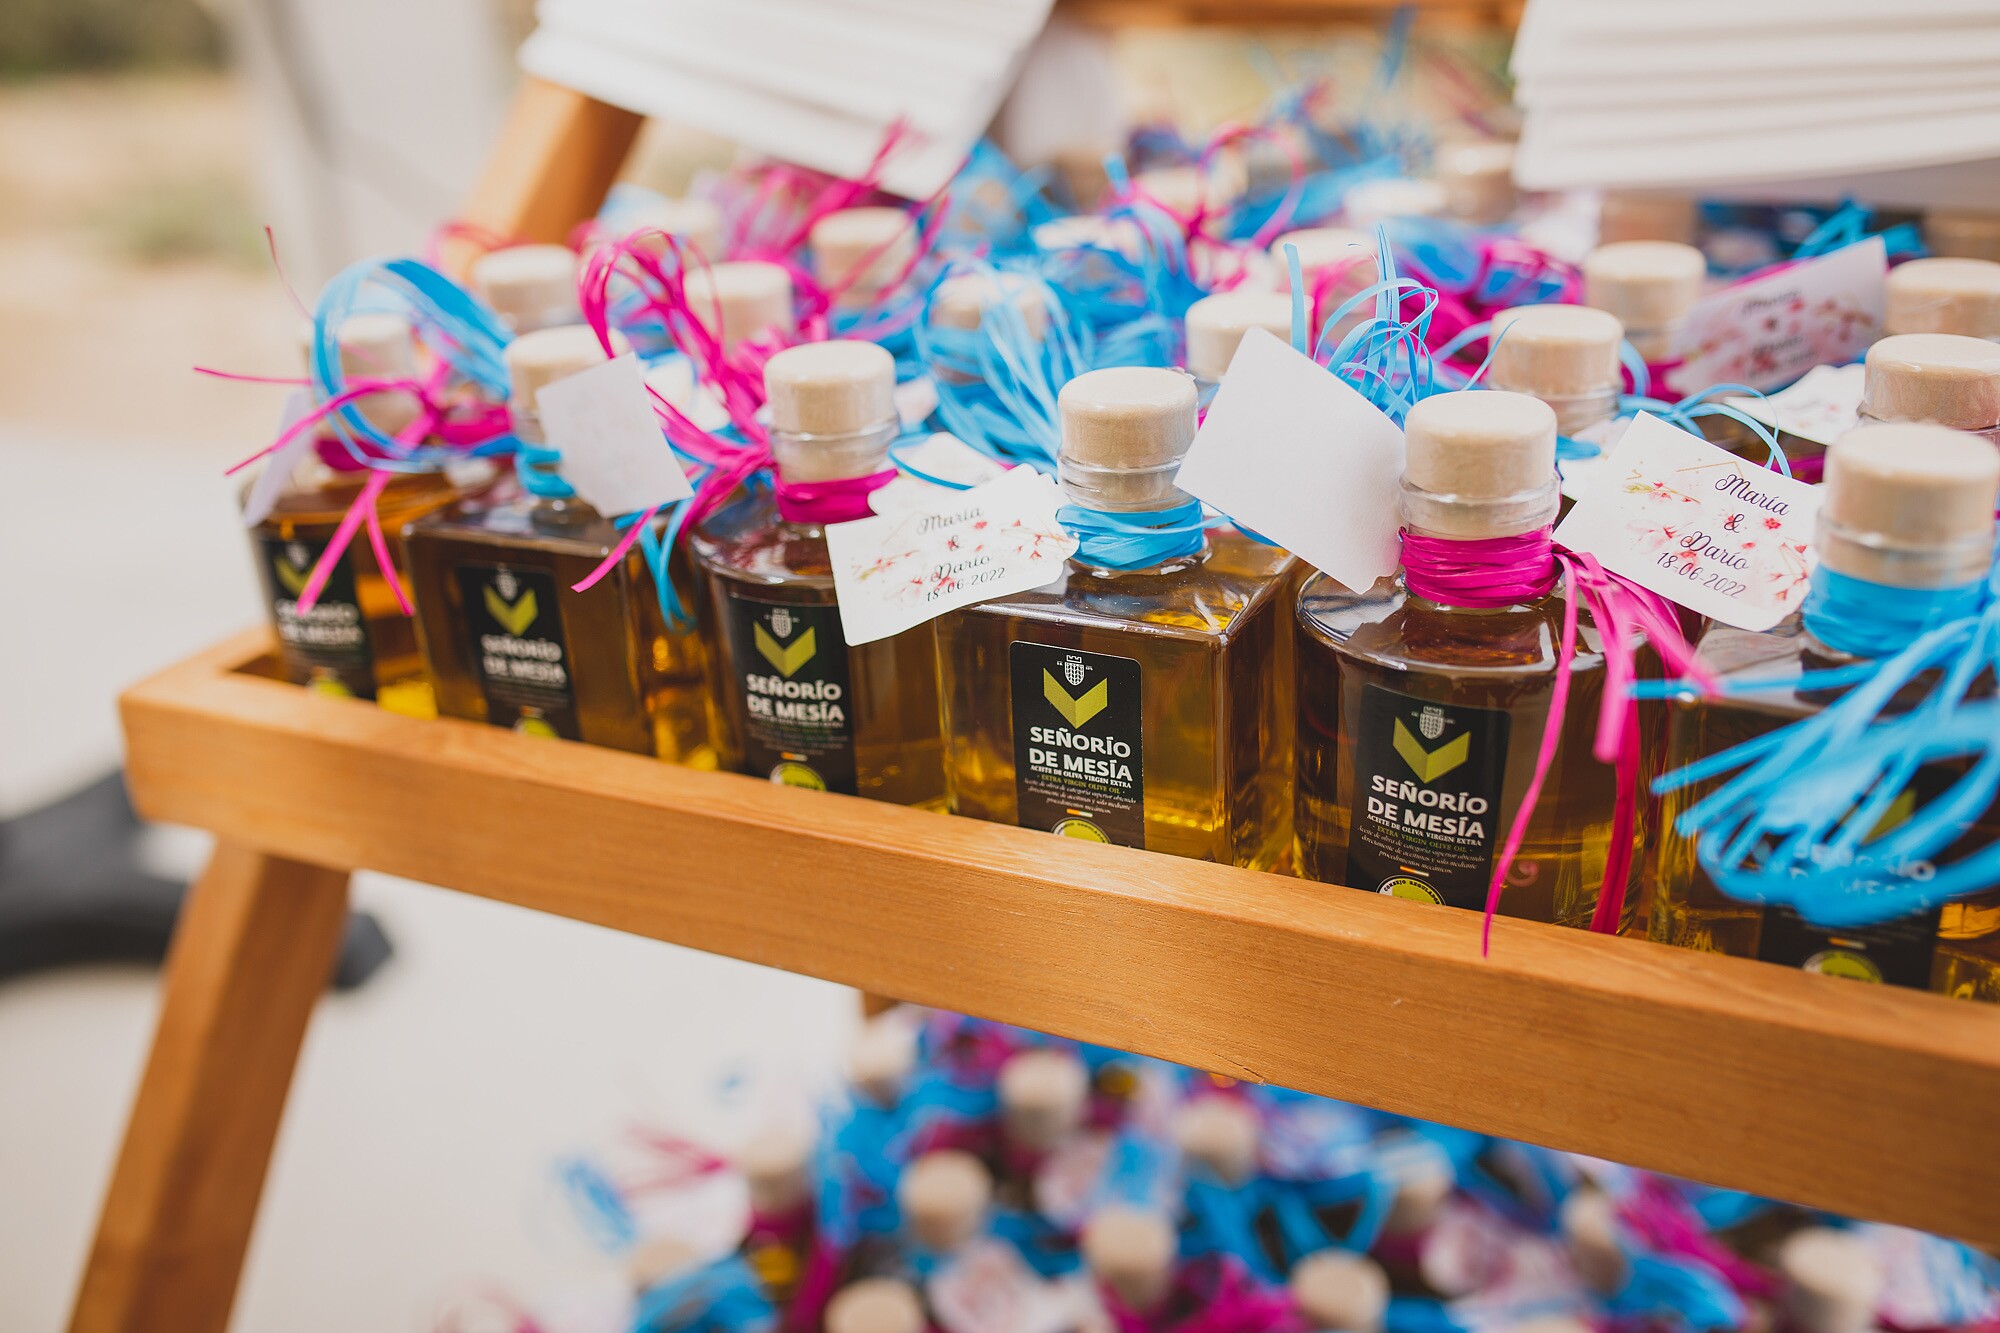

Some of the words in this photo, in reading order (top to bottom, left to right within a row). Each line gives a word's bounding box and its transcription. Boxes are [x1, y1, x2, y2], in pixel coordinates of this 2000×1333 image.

[1714, 474, 1790, 516] María
[1724, 513, 1745, 534] &
[949, 535, 962, 551] &
[1680, 531, 1750, 570] Darío
[1656, 552, 1746, 599] 18-06-2022
[746, 673, 842, 701] SEÑORÍO
[747, 694, 773, 716] DE
[775, 700, 845, 722] MESÍA
[1030, 726, 1131, 758] SEÑORÍO
[1029, 748, 1058, 768] DE
[1063, 754, 1133, 782] MESÍA
[1030, 765, 1052, 774] ACEITE
[1063, 771, 1083, 780] OLIVA
[1084, 774, 1109, 785] VIRGEN
[1110, 779, 1131, 789] EXTRA
[1041, 774, 1061, 784] EXTRA
[1063, 778, 1087, 788] VIRGIN
[1088, 783, 1107, 792] OLIVE
[1108, 787, 1121, 795] OIL
[1371, 774, 1488, 814] SEÑORÍO
[1367, 796, 1398, 822] DE
[1403, 809, 1485, 839] MESÍA
[1367, 814, 1390, 827] ACEITE
[1391, 822, 1401, 830] DE
[1401, 826, 1424, 837] OLIVA
[1426, 832, 1454, 843] VIRGEN
[1456, 837, 1482, 847] EXTRA
[1377, 825, 1399, 838] EXTRA
[1401, 834, 1427, 846] VIRGIN
[1429, 841, 1452, 851] OLIVE
[1453, 845, 1467, 853] OIL
[1383, 879, 1406, 892] CONSEJO
